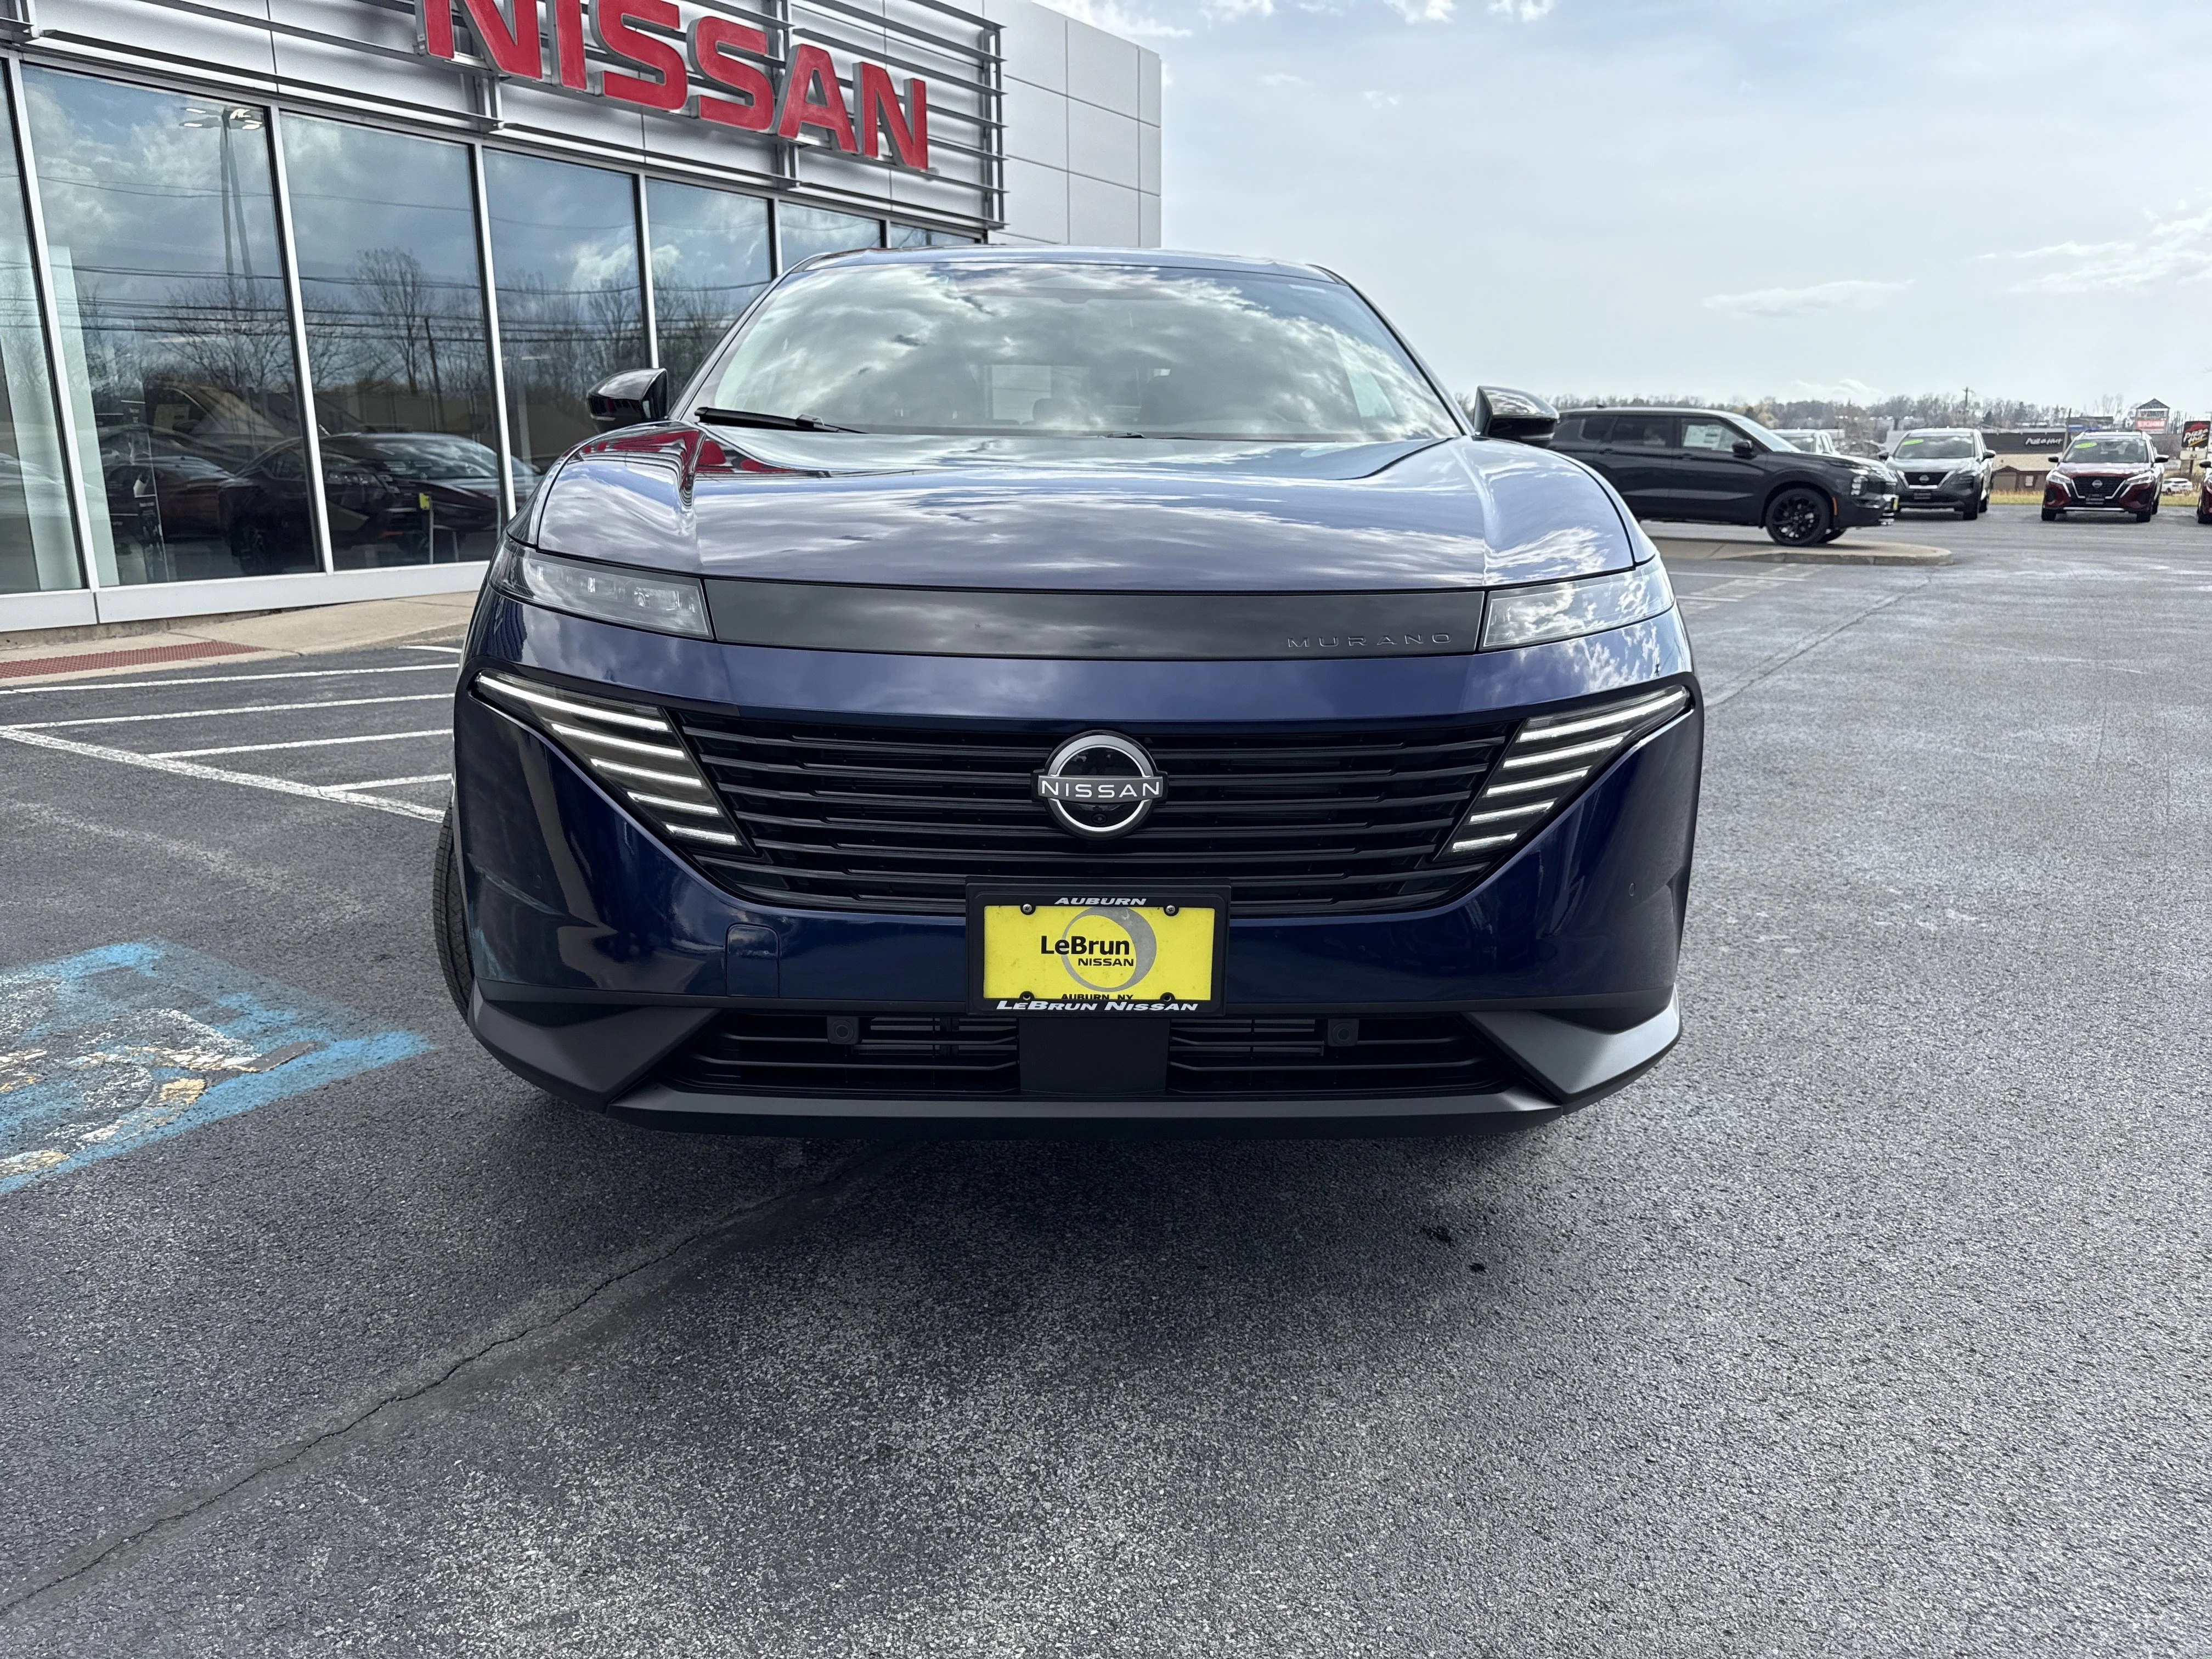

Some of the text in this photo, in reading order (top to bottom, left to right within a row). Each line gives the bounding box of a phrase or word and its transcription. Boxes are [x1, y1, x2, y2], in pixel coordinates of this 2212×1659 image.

[424, 0, 929, 170] NISSAN
[1287, 633, 1452, 647] MURANO
[1041, 780, 1160, 798] NISSAN
[1054, 897, 1147, 906] AUBURN
[1040, 935, 1130, 956] LeBrun
[1077, 958, 1134, 967] NISSAN
